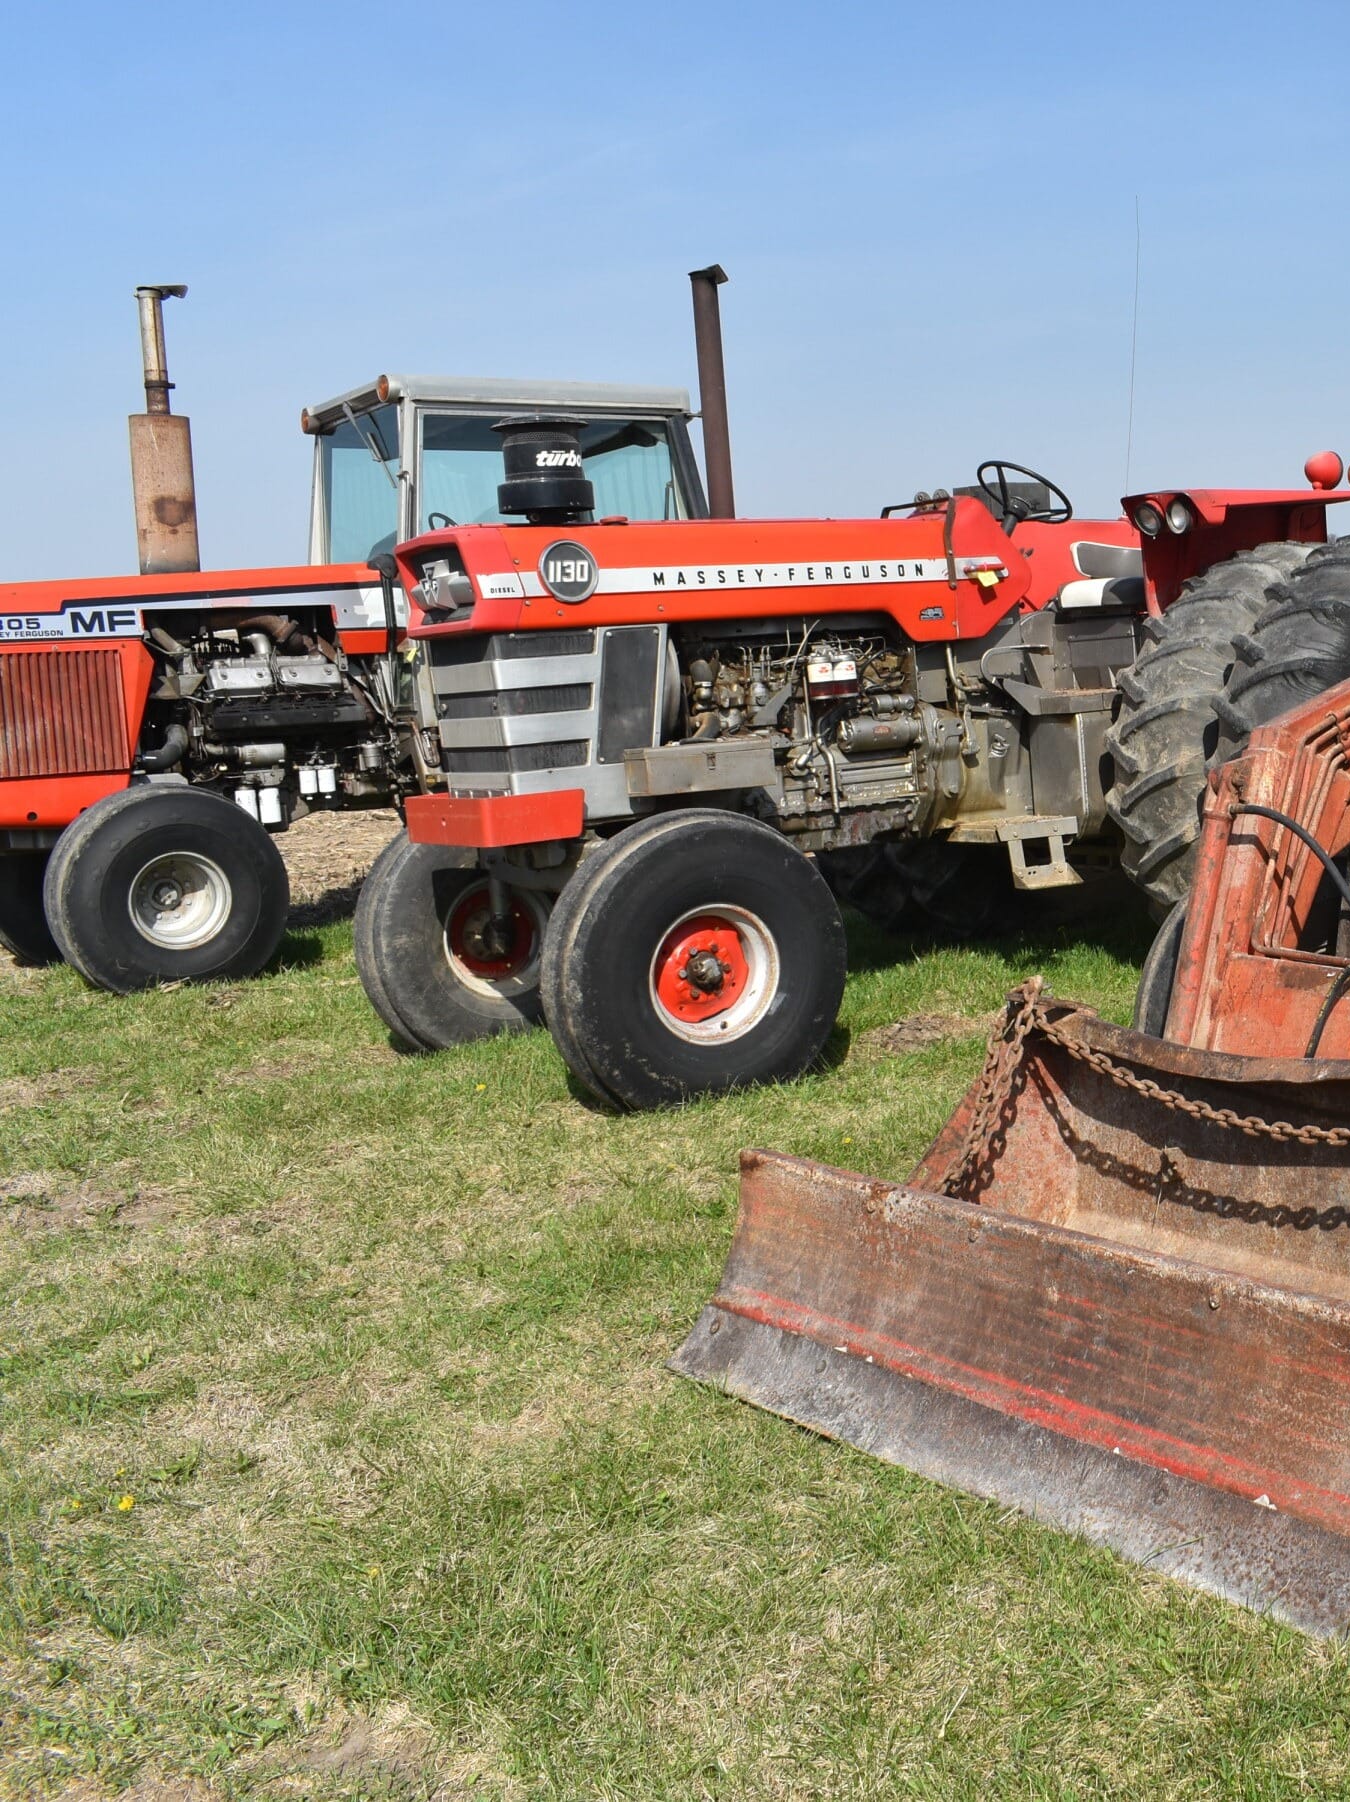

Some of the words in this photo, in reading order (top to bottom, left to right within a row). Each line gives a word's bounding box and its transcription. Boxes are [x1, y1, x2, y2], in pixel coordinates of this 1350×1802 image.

[535, 449, 582, 468] turbo
[548, 560, 589, 583] 1130
[490, 586, 516, 594] DIESEL
[0, 618, 41, 630] 05
[70, 610, 136, 633] MF
[14, 630, 64, 638] FERGUSON
